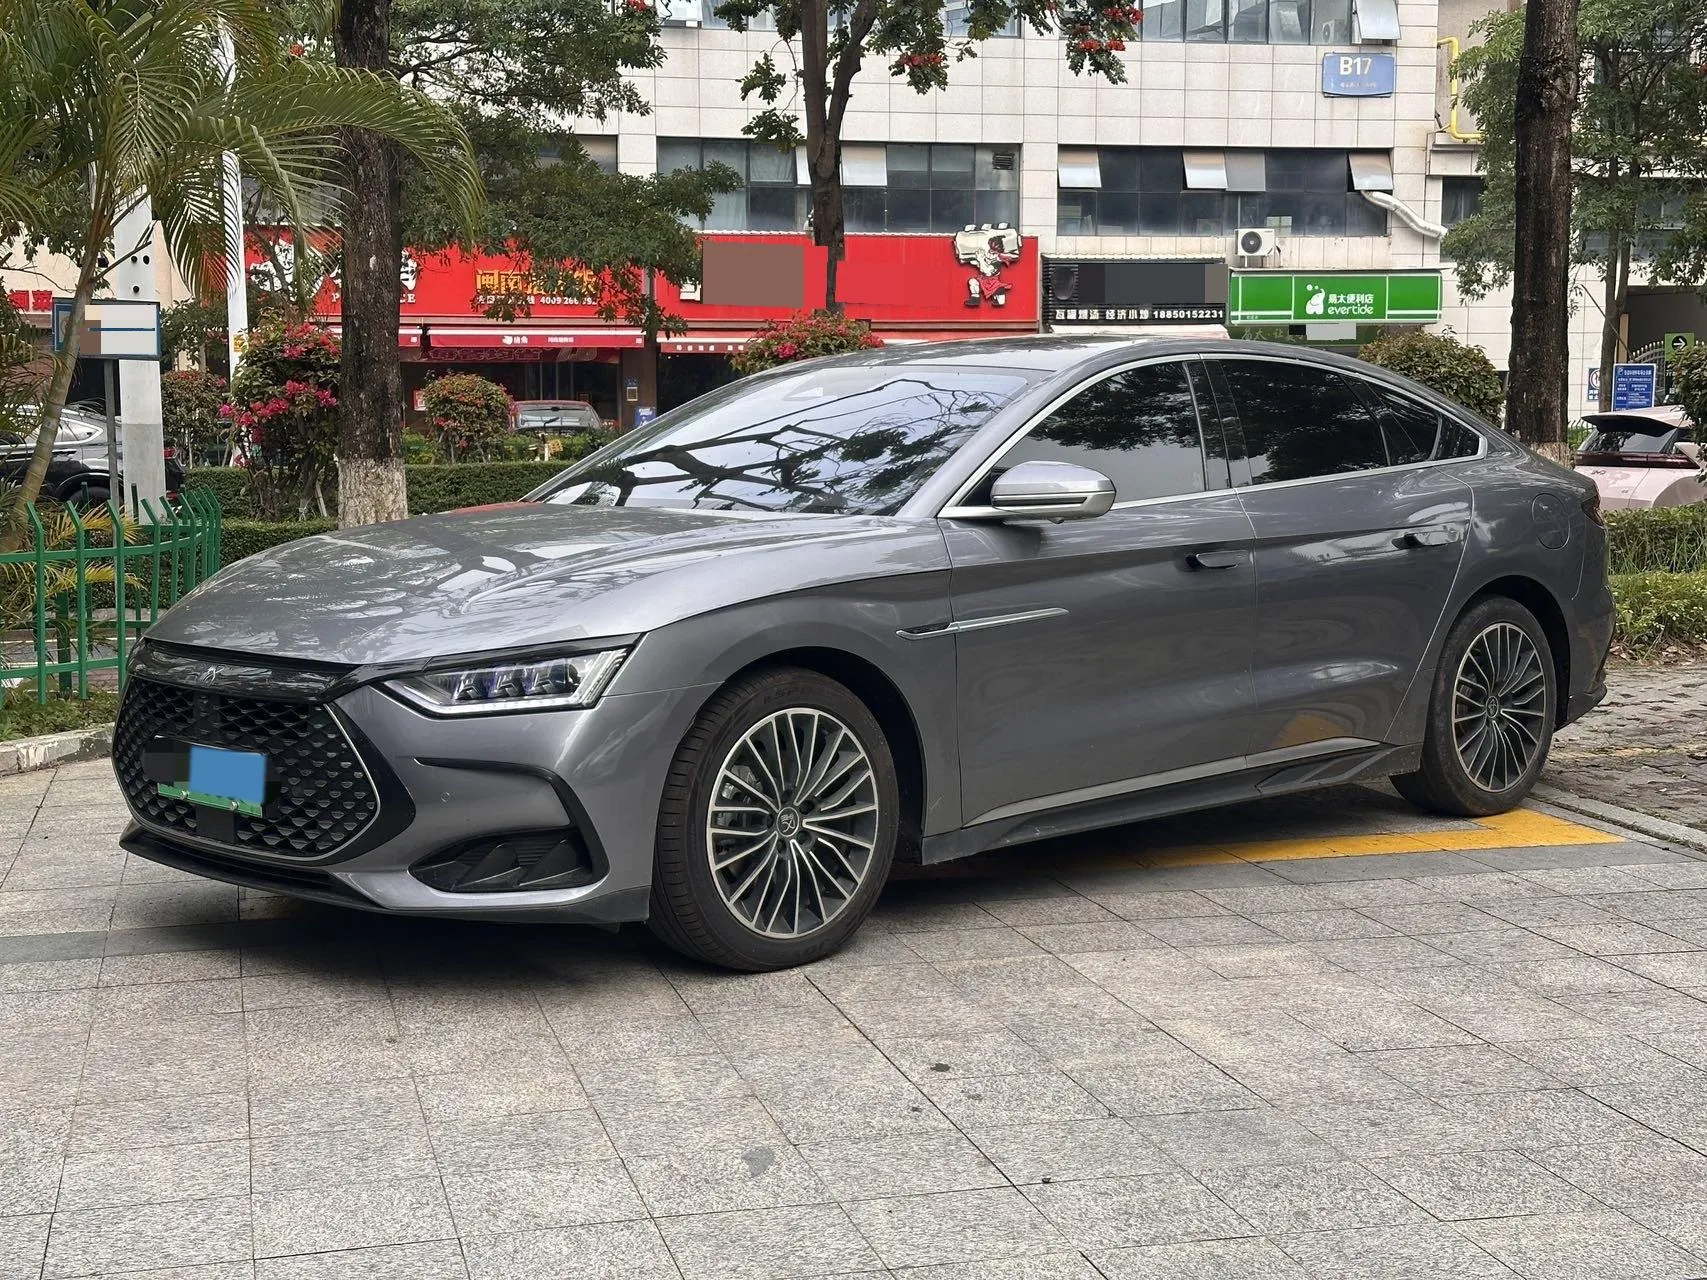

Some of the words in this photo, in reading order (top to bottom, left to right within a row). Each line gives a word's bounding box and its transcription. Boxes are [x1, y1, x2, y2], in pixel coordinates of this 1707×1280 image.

[1340, 56, 1372, 75] B17
[1105, 309, 1149, 320] 经济小炒
[1153, 310, 1223, 319] 18850152231
[1328, 304, 1374, 315] evertide
